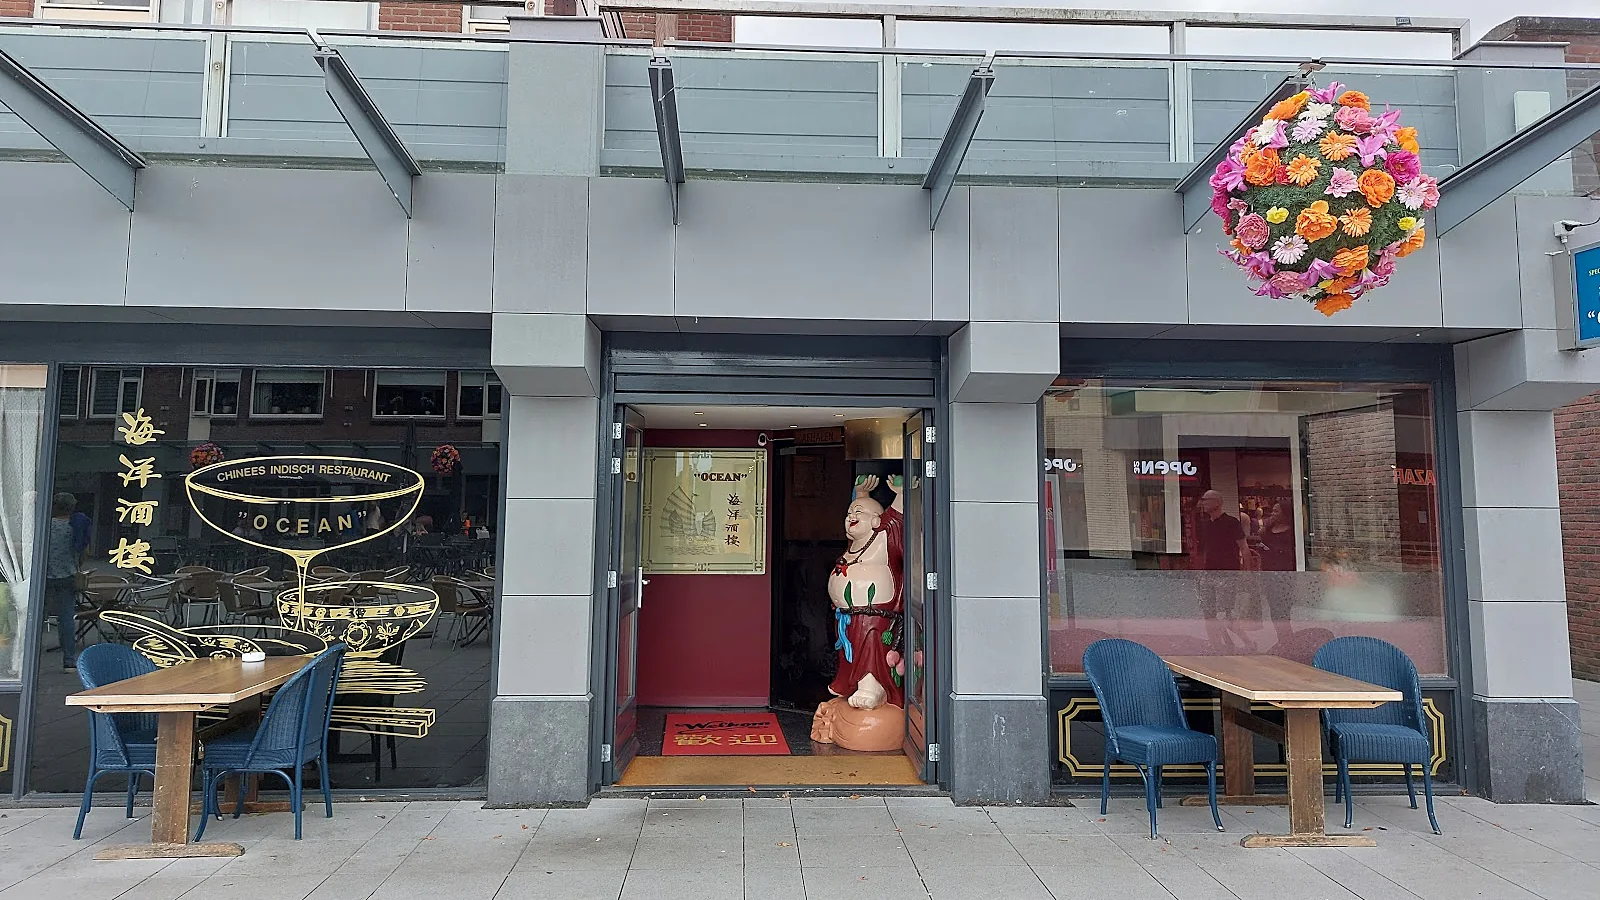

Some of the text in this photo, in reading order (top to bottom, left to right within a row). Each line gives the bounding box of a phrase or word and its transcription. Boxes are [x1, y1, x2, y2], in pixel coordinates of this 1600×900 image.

[216, 464, 392, 483] CHINEES INDISCH RESTAURANT
